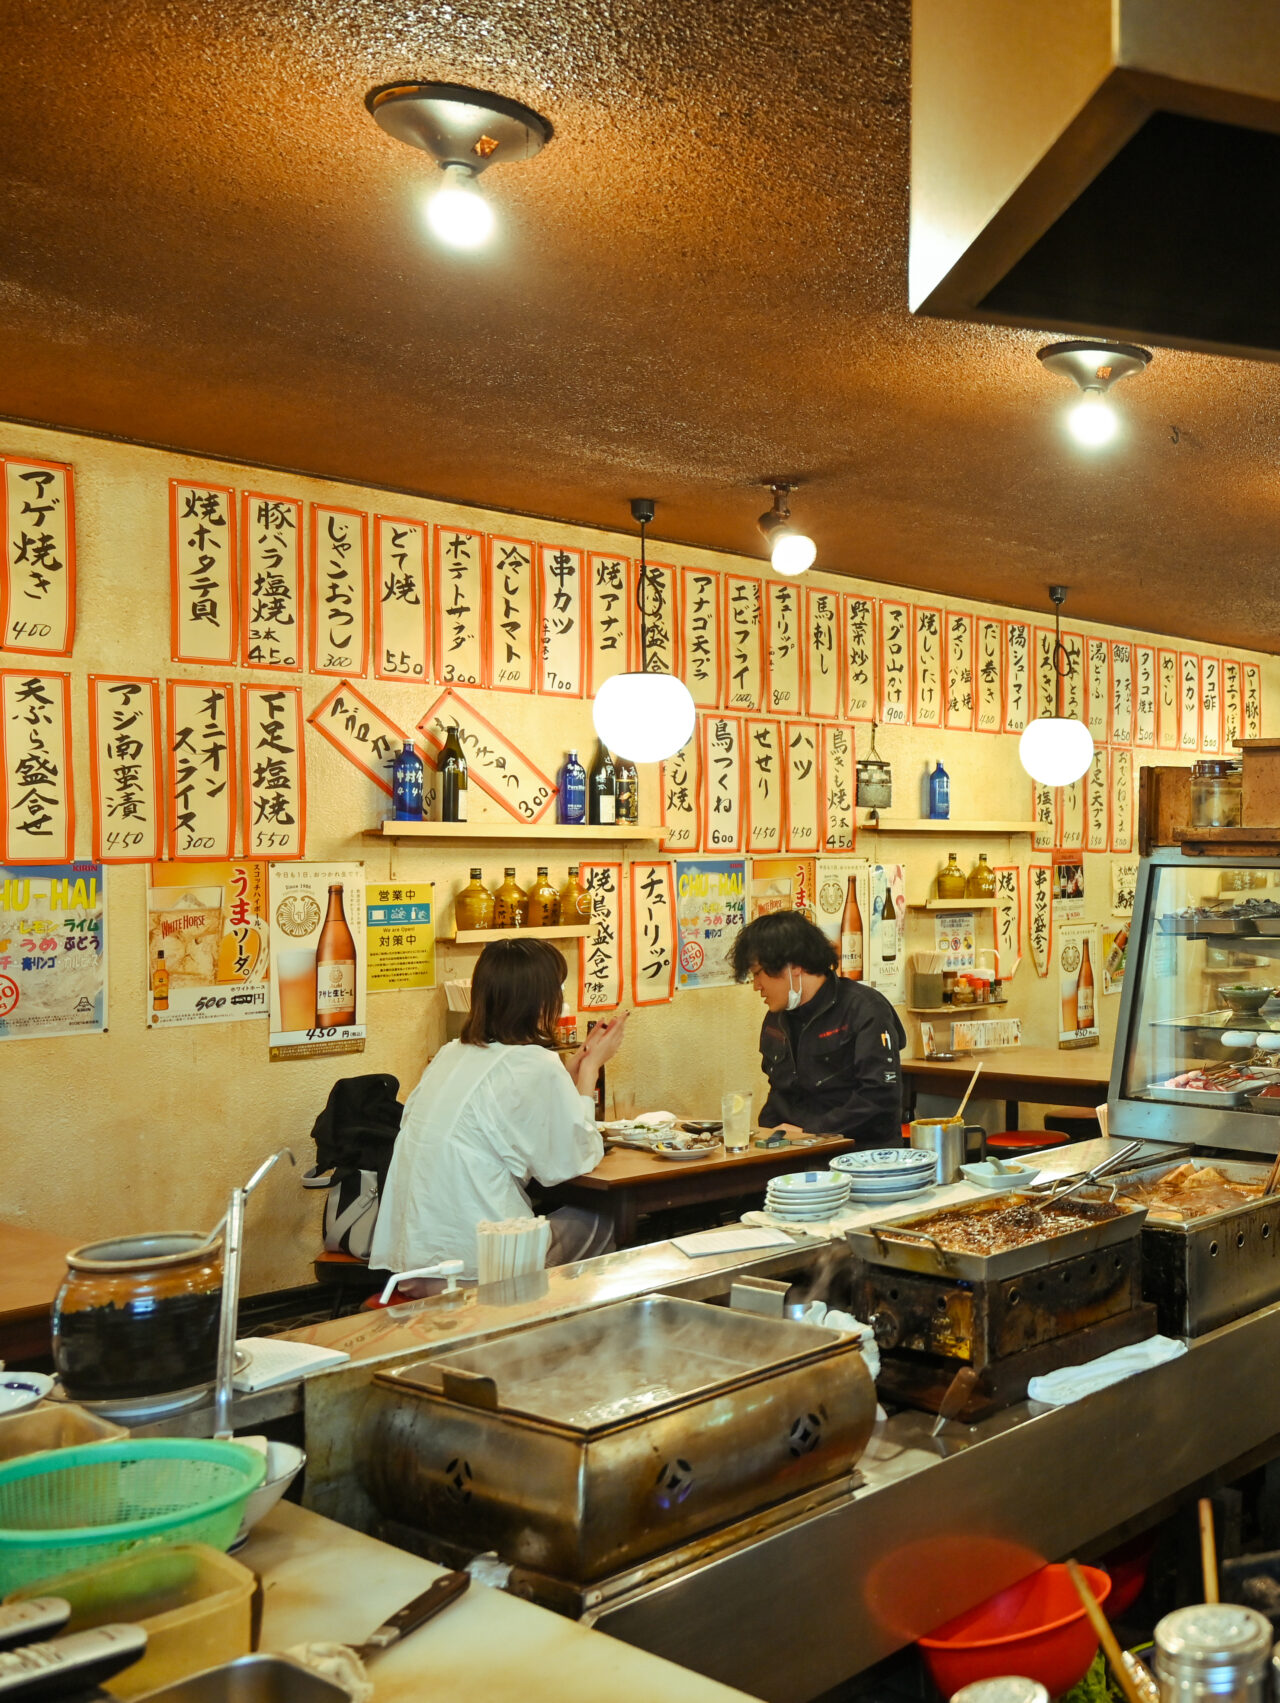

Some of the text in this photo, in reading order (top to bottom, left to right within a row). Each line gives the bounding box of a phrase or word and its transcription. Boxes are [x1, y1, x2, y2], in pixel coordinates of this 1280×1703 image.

[13, 471, 63, 600] アゲ焼き
[181, 489, 227, 628] 焼ホタテ貝
[251, 501, 297, 627] 豚バラ塩焼
[381, 526, 421, 606] どて焼
[445, 532, 475, 653] ポテトサラダ
[496, 545, 530, 664] 冷しトマト
[549, 550, 577, 636] 串カツ
[597, 561, 624, 651] 焼アナゴ
[13, 621, 52, 640] 400
[731, 585, 750, 690] エビフライ
[775, 586, 795, 659] チューリップ
[814, 596, 835, 675] 馬刺し
[951, 616, 968, 661] あさり
[249, 648, 296, 666] 450
[850, 600, 870, 685] 野菜炒め
[886, 609, 905, 704] マグロ山かけ
[917, 612, 938, 704] 焼しいたけ
[323, 654, 353, 669] 300
[383, 649, 424, 676] 550
[443, 664, 477, 685] 300
[980, 623, 998, 705] だし巻き
[1009, 624, 1027, 711] 揚シューマイ
[1141, 652, 1151, 696] タラコ
[547, 672, 572, 691] 700
[1162, 655, 1174, 707] めざし
[1184, 659, 1197, 712] ハムカツ
[1203, 664, 1217, 711] タコ酢
[773, 689, 791, 706] 800
[887, 708, 904, 720] 900
[1008, 720, 1024, 730] 400
[11, 678, 60, 837] 天ぷら盛合せ
[106, 683, 147, 823] アジ南蛮漬
[196, 688, 229, 799] オニオン
[252, 691, 296, 828] 下足塩焼
[789, 731, 814, 781] ハツ
[711, 718, 734, 814] 鳥つくね
[753, 728, 773, 800] せせり
[172, 727, 201, 834] スライス
[421, 788, 437, 816] 00
[518, 787, 549, 819] 300
[106, 831, 145, 851] 450
[182, 834, 217, 852] 300
[255, 831, 291, 849] 550
[711, 829, 734, 844] 600
[826, 835, 853, 850] 450
[72, 864, 98, 872] KIRIN
[378, 889, 416, 902] 営業中
[678, 872, 743, 897] CHU-HAI
[19, 920, 58, 935] レモン
[63, 919, 100, 933] ライム
[161, 915, 206, 938] WHITE HORSE
[640, 866, 670, 980] チューリップ
[703, 916, 723, 926] うめ
[20, 938, 58, 952] うめ
[63, 936, 101, 951] ぶどう
[378, 935, 417, 948] 対策中
[21, 956, 57, 971] 青リンゴ
[682, 949, 702, 967] 350
[195, 996, 227, 1011] 500
[318, 989, 354, 1000] アサヒ生ビール
[305, 1027, 338, 1041] 450
